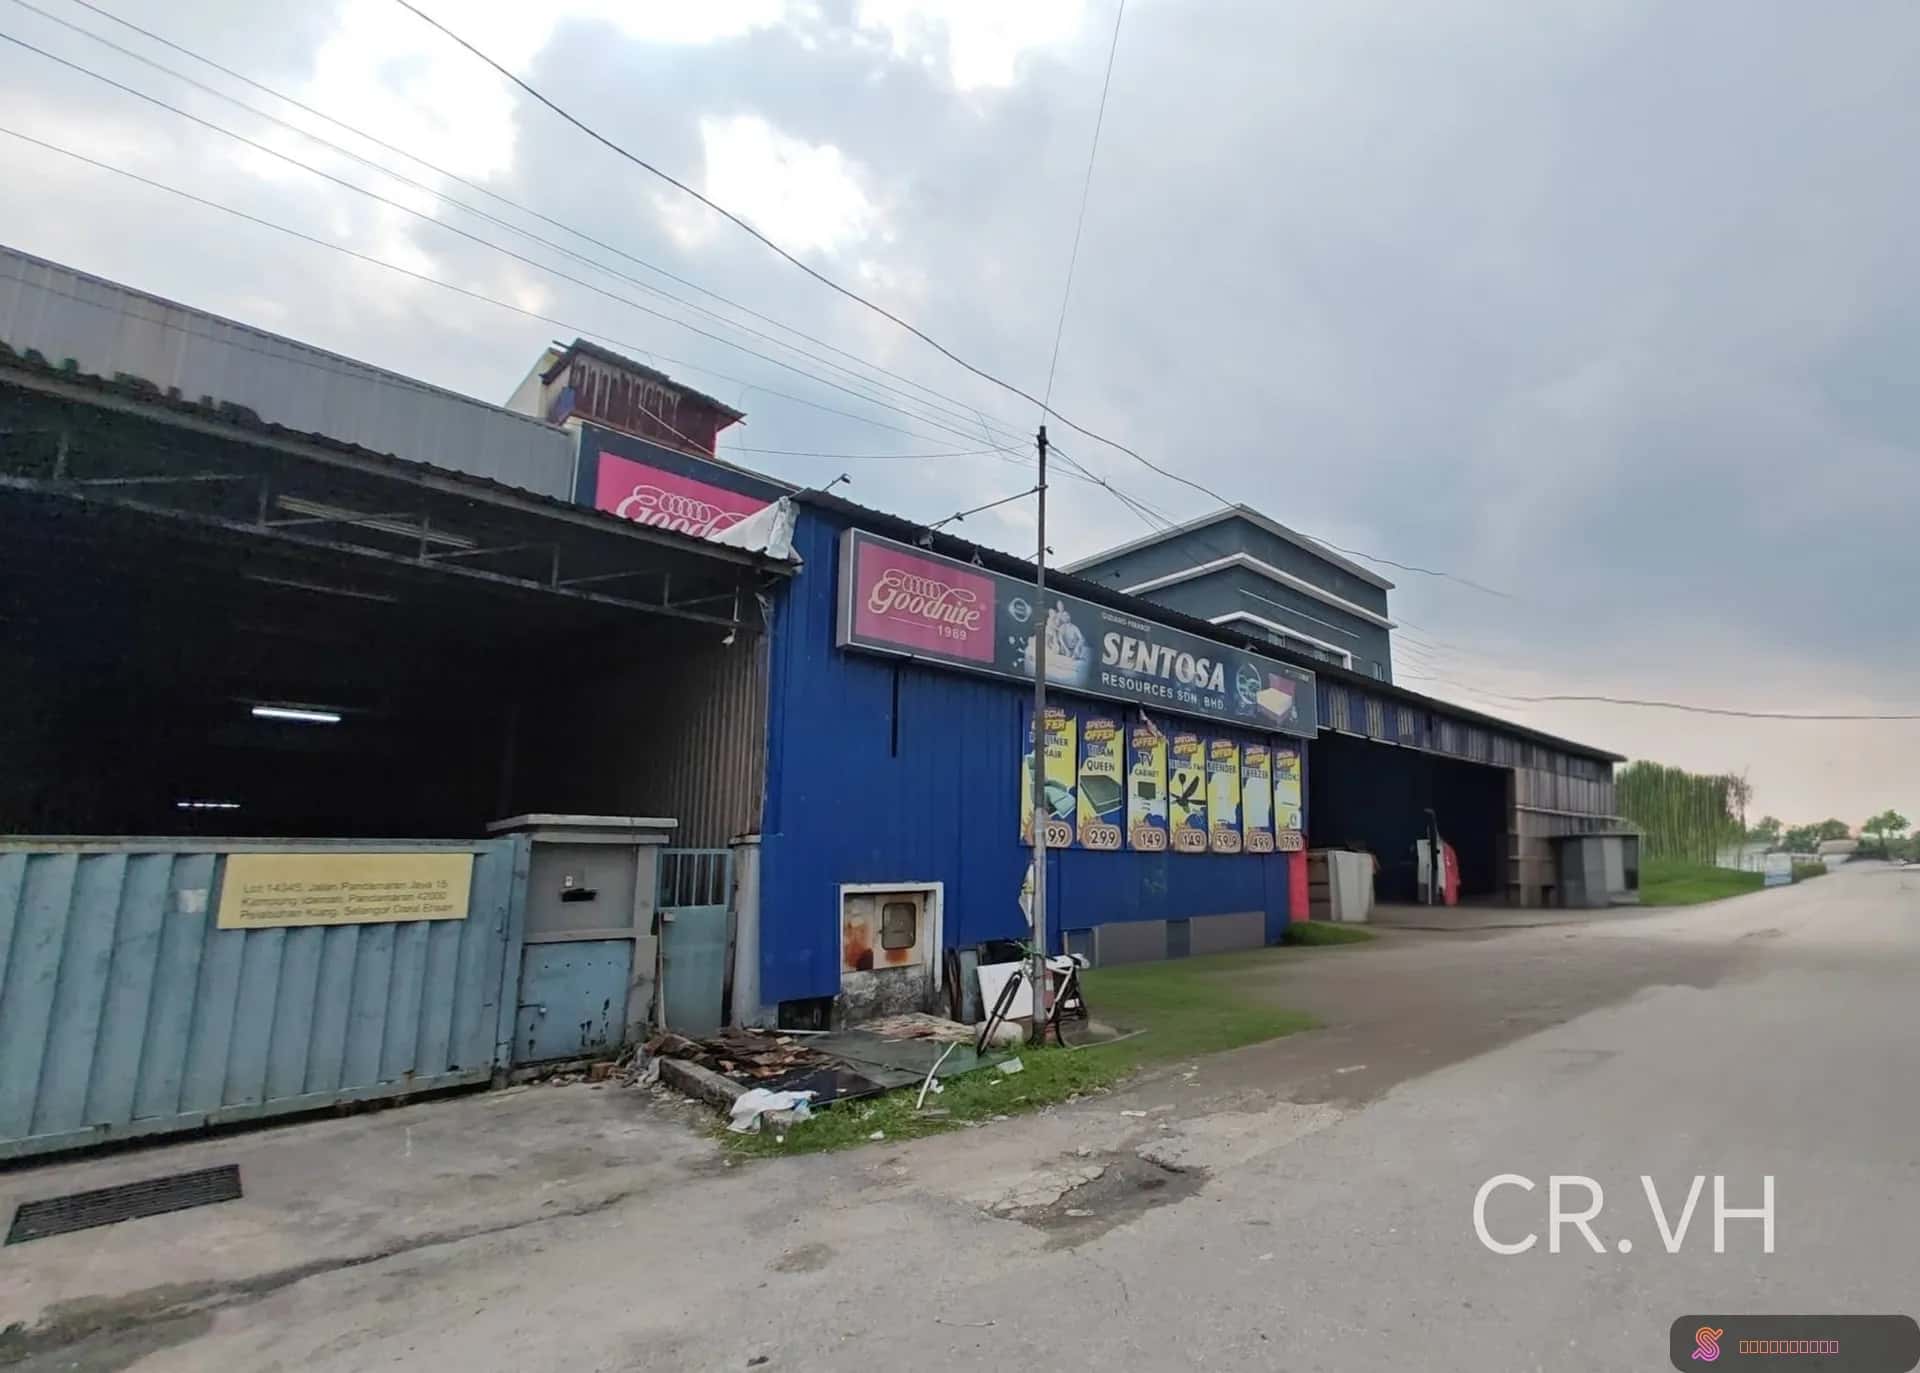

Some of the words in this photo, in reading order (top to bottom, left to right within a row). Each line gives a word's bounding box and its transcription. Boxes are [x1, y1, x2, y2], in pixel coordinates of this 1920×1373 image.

[868, 568, 981, 631] Goodnite
[1102, 632, 1225, 693] SENTOSA
[1101, 672, 1173, 699] RESOURCES
[1086, 760, 1116, 772] QUEEN
[1138, 752, 1154, 767] TV
[1091, 830, 1116, 845] 299
[1141, 832, 1161, 846] 149
